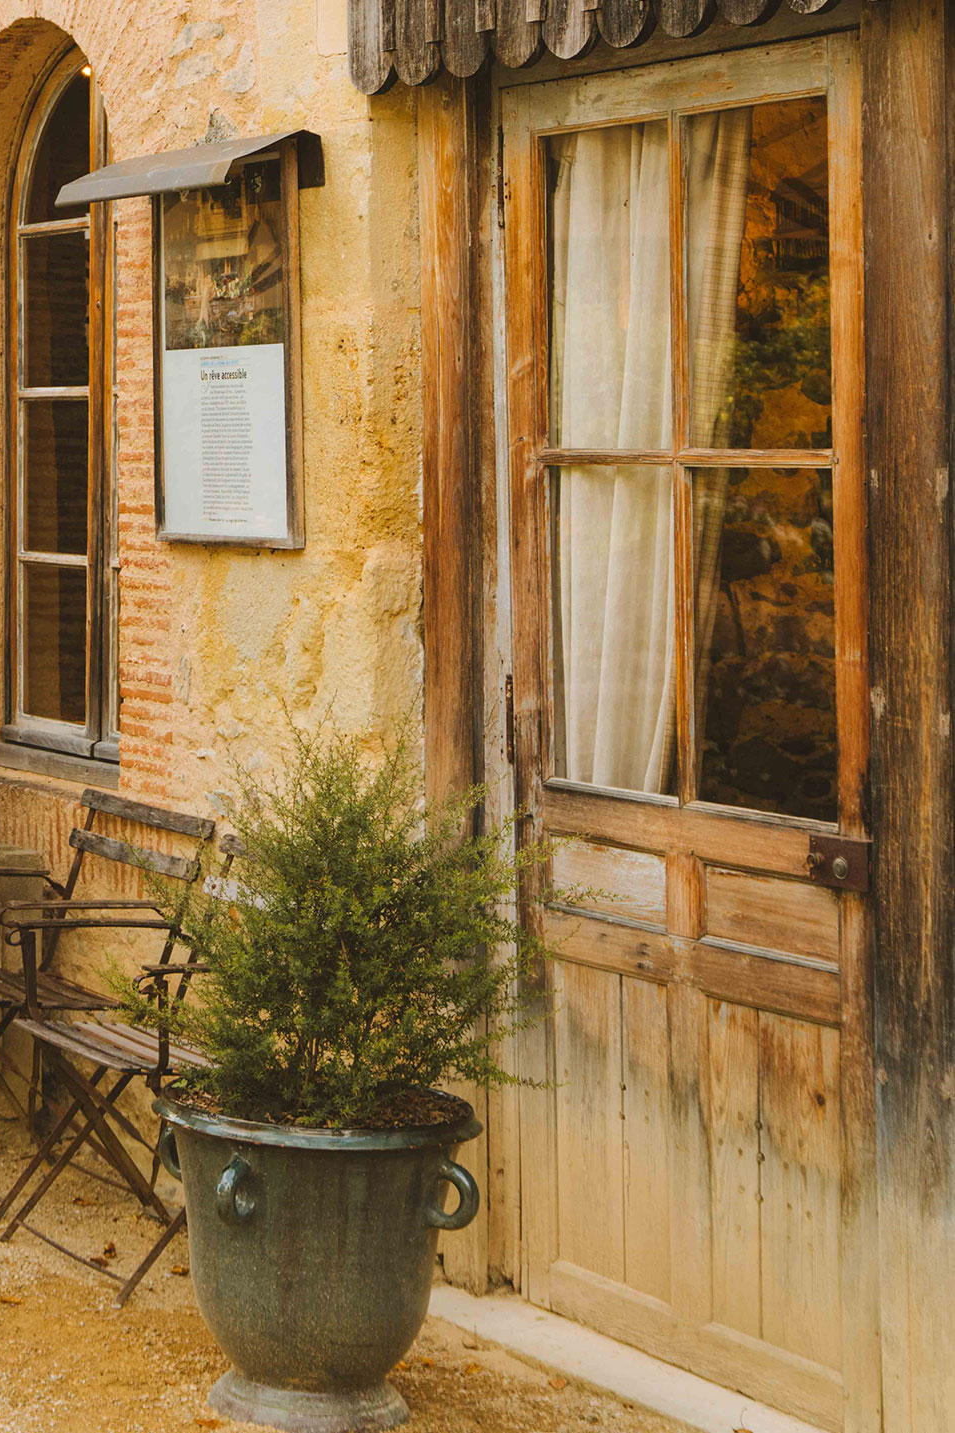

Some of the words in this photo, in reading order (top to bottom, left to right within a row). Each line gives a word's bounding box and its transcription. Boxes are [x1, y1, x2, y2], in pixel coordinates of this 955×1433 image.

[200, 369, 208, 381] Un
[209, 369, 221, 381] rêve
[221, 368, 247, 380] accessible
